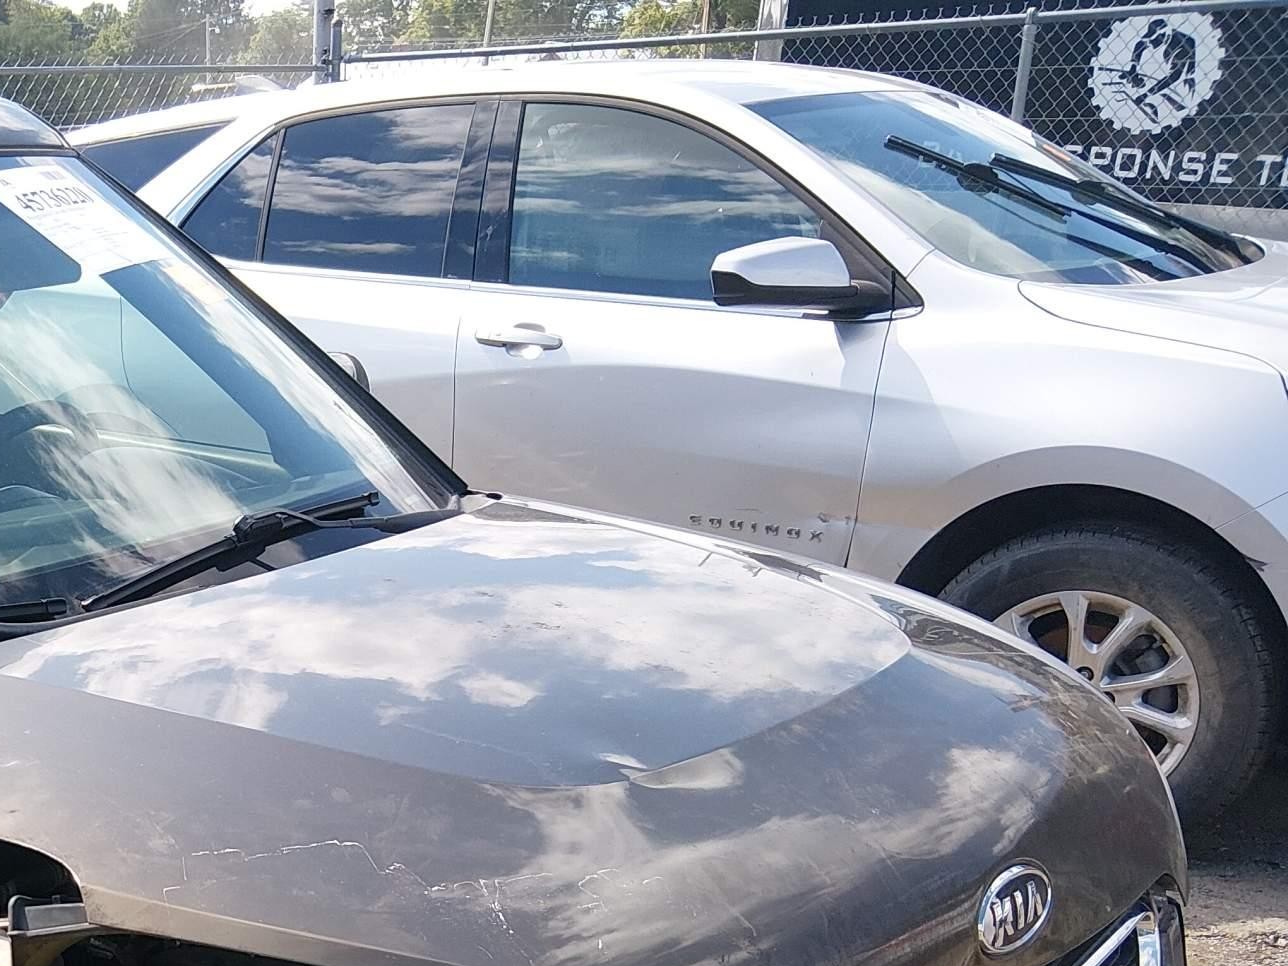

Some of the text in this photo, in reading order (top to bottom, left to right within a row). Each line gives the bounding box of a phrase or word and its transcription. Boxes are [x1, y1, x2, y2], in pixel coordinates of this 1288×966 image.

[1256, 154, 1288, 187] T
[689, 514, 824, 543] EQUINOX
[991, 880, 1043, 948] KIA
